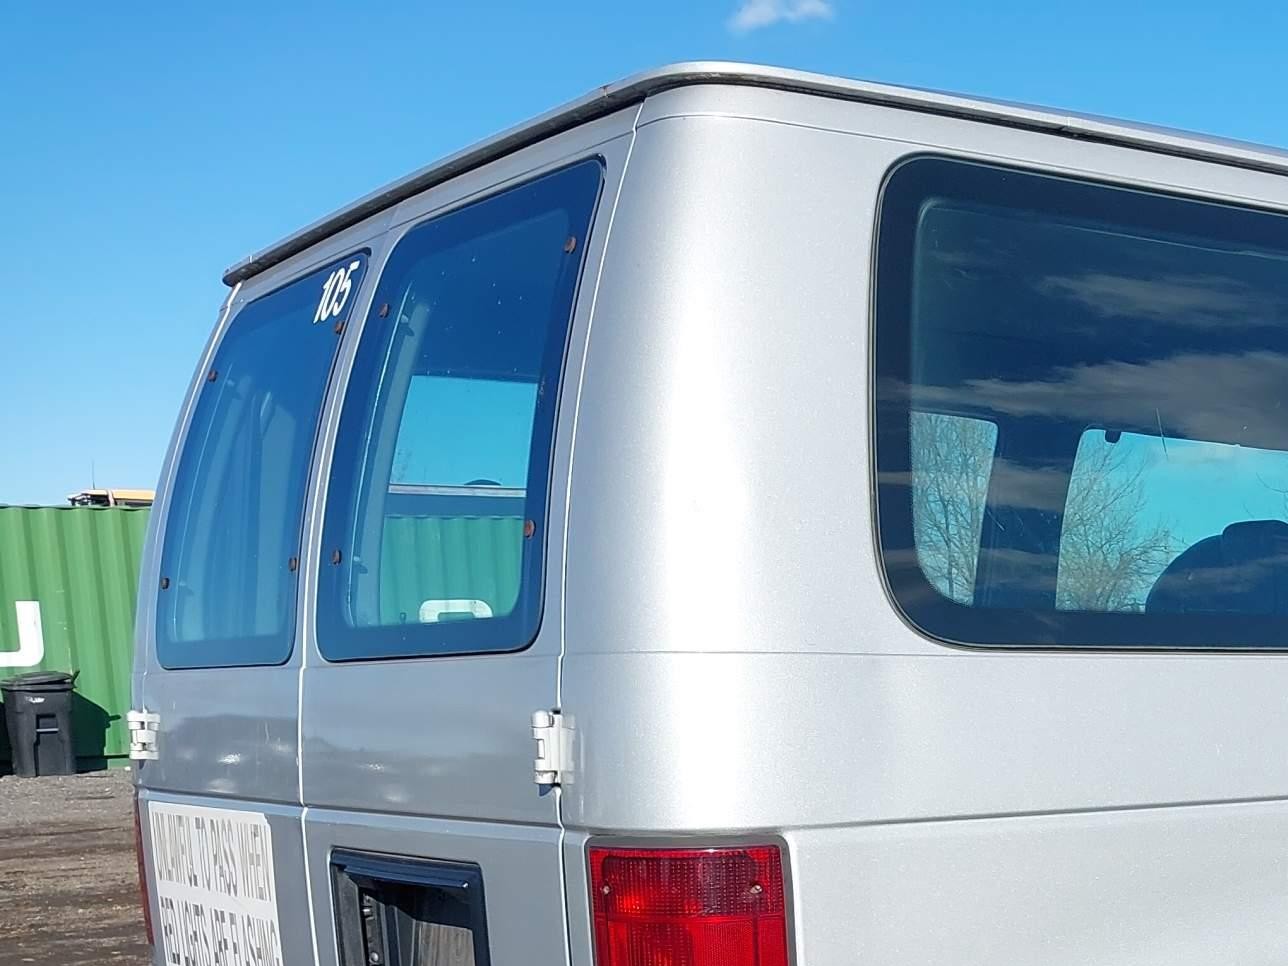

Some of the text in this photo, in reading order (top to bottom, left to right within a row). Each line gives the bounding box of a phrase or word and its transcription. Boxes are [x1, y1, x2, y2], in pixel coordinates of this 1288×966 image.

[313, 260, 361, 324] 105
[194, 816, 212, 892] TO
[209, 818, 239, 898] PASS
[236, 821, 273, 903] WHEN
[159, 894, 181, 966] RED
